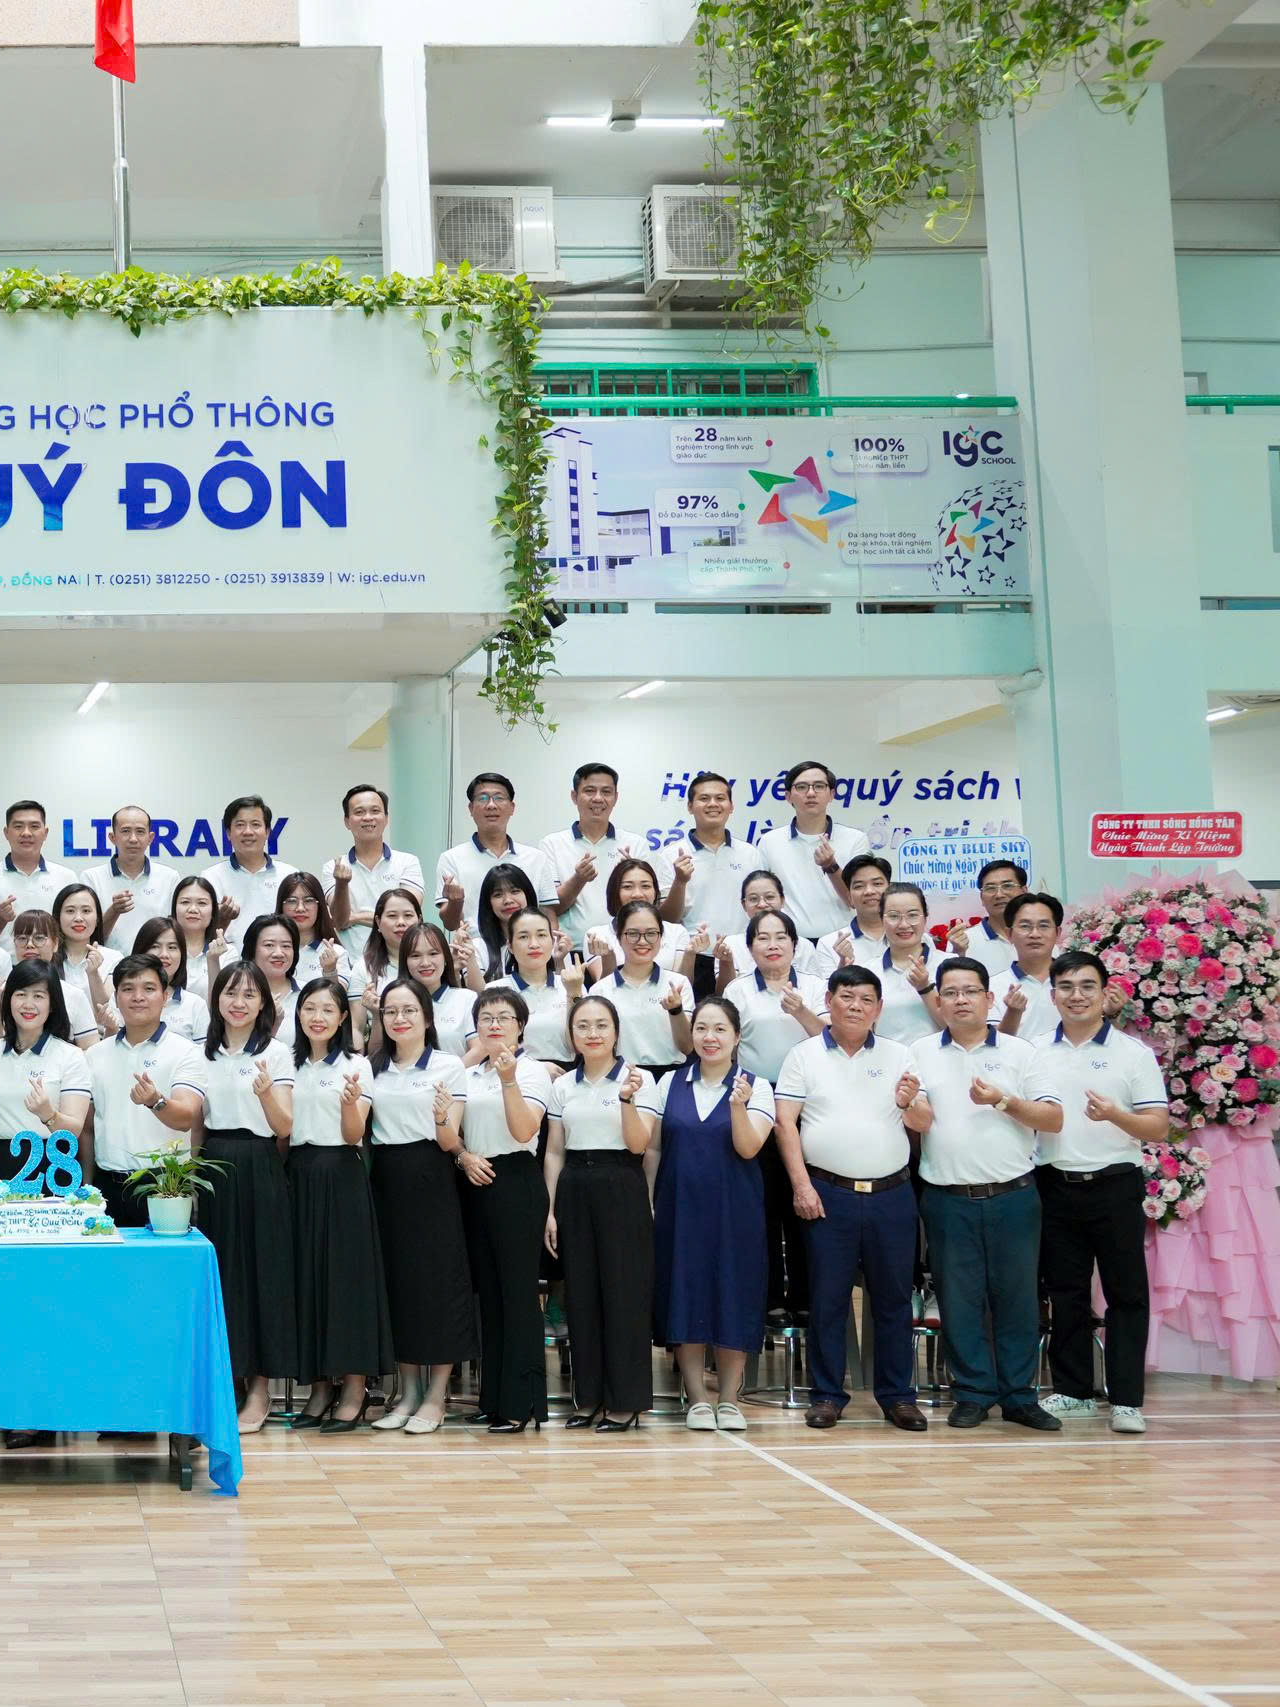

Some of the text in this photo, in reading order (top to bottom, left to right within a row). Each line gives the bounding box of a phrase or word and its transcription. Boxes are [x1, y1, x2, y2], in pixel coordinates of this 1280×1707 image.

[29, 404, 107, 436] HỌC
[120, 391, 194, 430] PHỔ
[206, 395, 336, 428] THÔNG
[694, 427, 718, 442] 28
[854, 438, 905, 452] 100%
[981, 457, 1016, 465] SCHOOL
[118, 440, 347, 531] ĐÔN
[677, 495, 719, 510] 97%
[109, 573, 151, 587] (0251)
[156, 574, 211, 586] 3812250
[224, 573, 266, 586] (0251)
[270, 573, 325, 585] 3913839
[337, 573, 355, 584] W:
[359, 572, 426, 586] igc.edu.vn
[746, 770, 787, 807] yê
[834, 770, 903, 808] quý
[913, 769, 1000, 801] sách
[1122, 820, 1135, 829] TY
[903, 841, 1026, 857] CÔNG TY BLUE SKY
[904, 859, 925, 875] Chúc
[927, 858, 952, 875] Mừng
[955, 857, 977, 874] Ngày
[9, 1129, 83, 1196] 28
